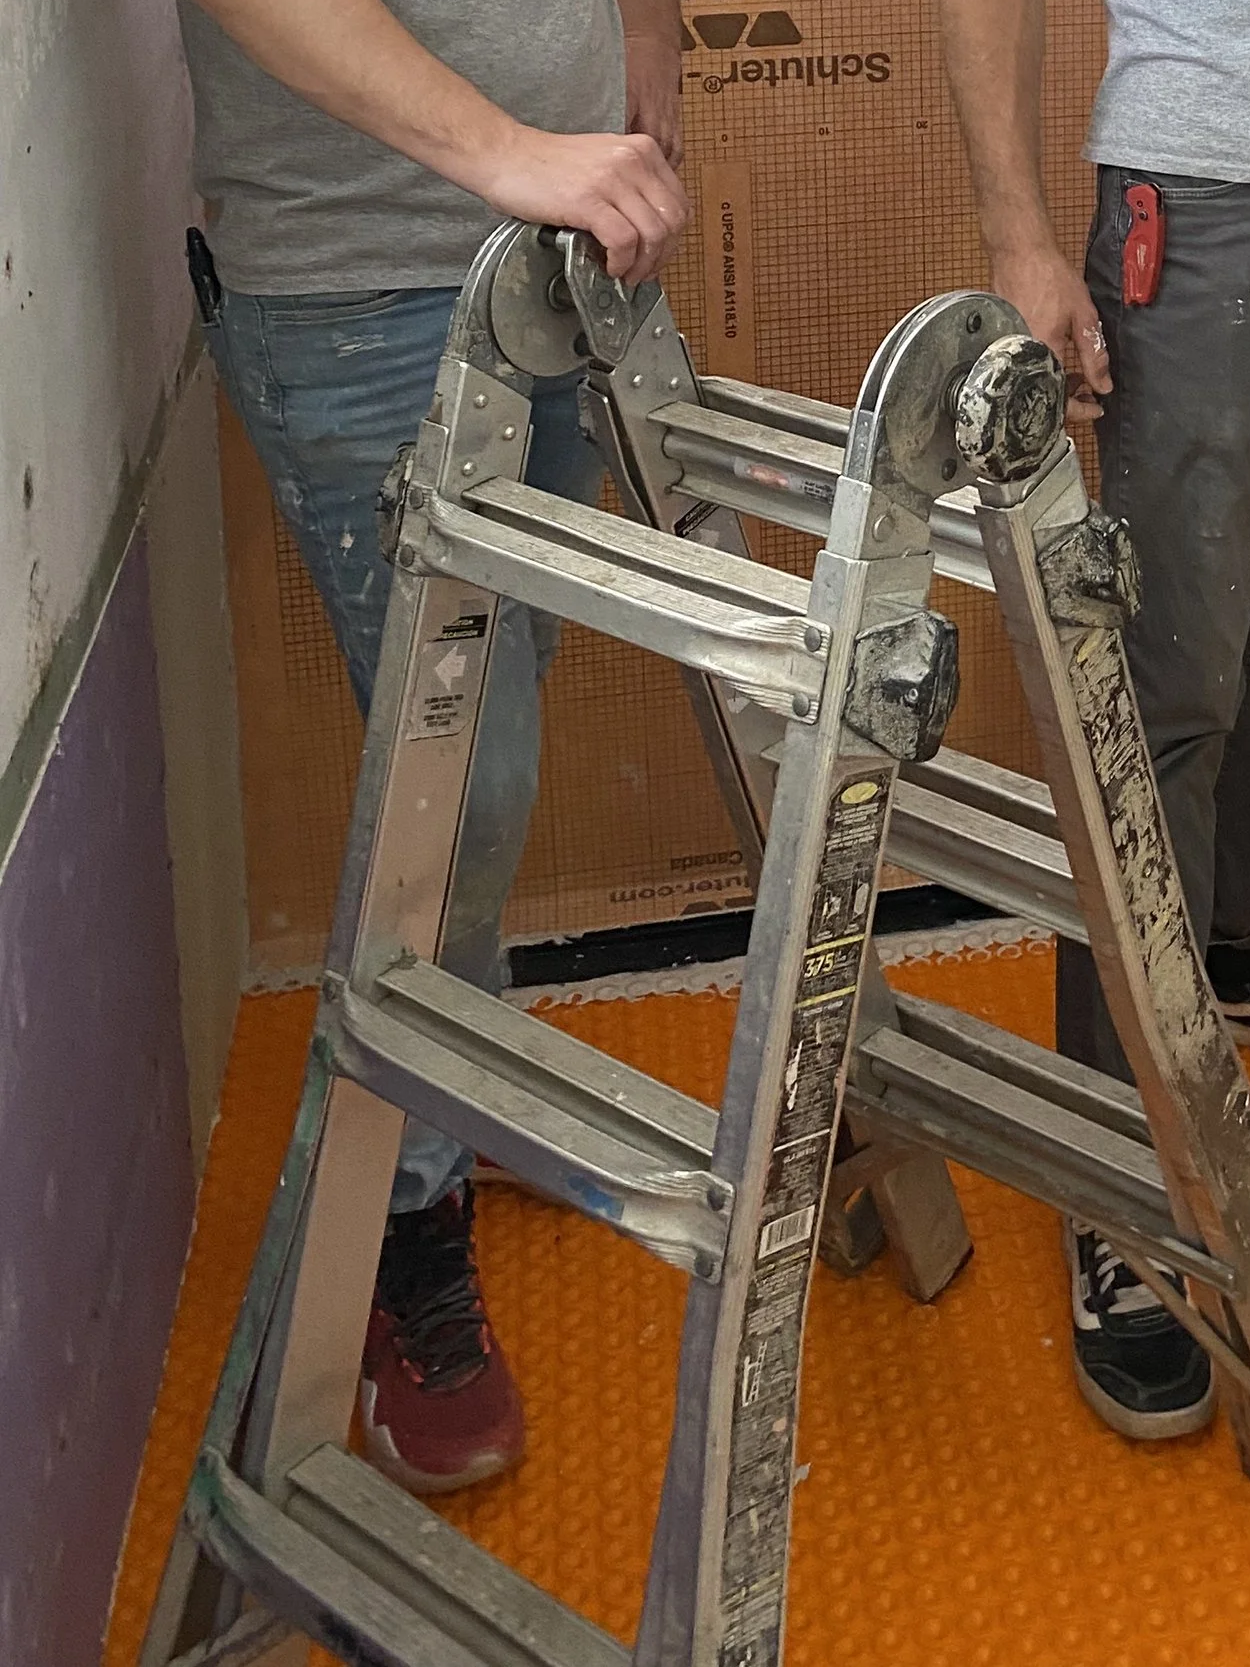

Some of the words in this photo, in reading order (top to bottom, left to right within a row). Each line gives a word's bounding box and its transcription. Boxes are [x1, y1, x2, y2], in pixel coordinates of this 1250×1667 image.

[678, 51, 891, 95] Schluter®-
[818, 126, 830, 135] 10
[723, 255, 735, 286] ANSI
[724, 289, 737, 338] A118.10
[670, 850, 743, 872] Canada
[804, 951, 834, 979] 375
